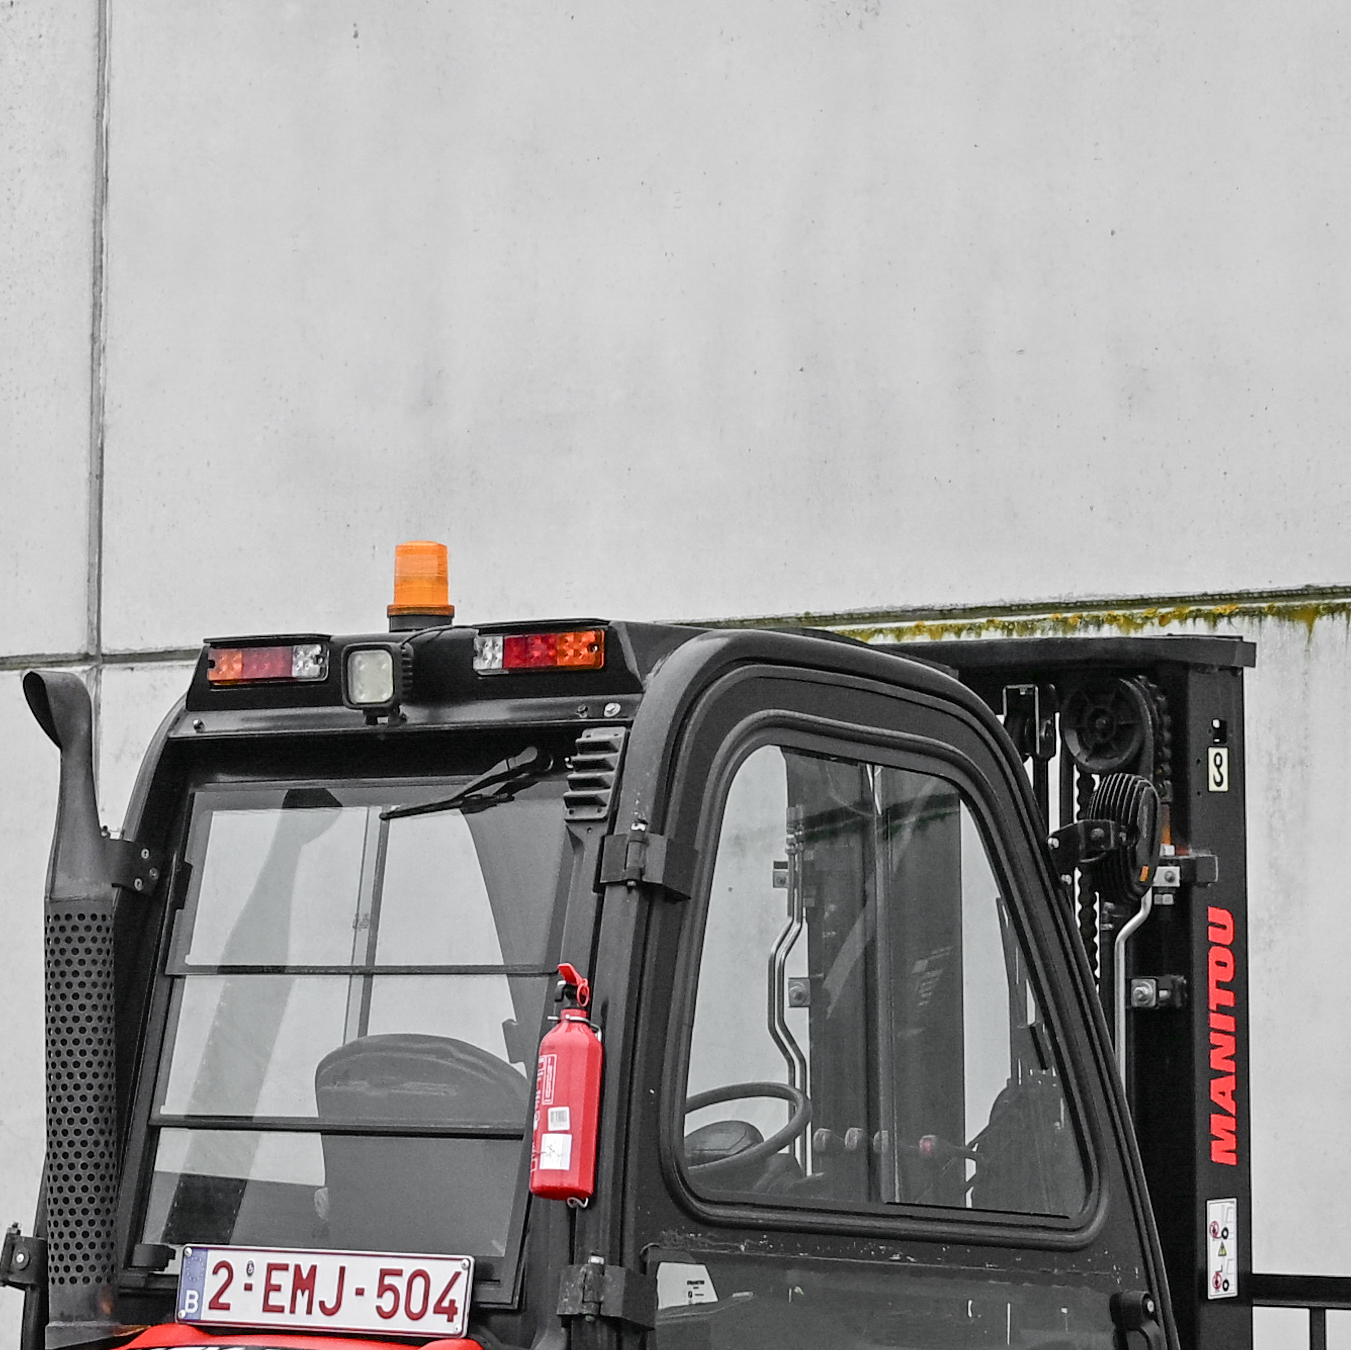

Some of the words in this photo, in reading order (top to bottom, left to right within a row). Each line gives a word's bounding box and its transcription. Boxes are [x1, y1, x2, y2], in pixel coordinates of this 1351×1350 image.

[1207, 906, 1238, 1166] MANITOU
[184, 1289, 199, 1314] B
[208, 1260, 462, 1323] 2-EMJ-504
